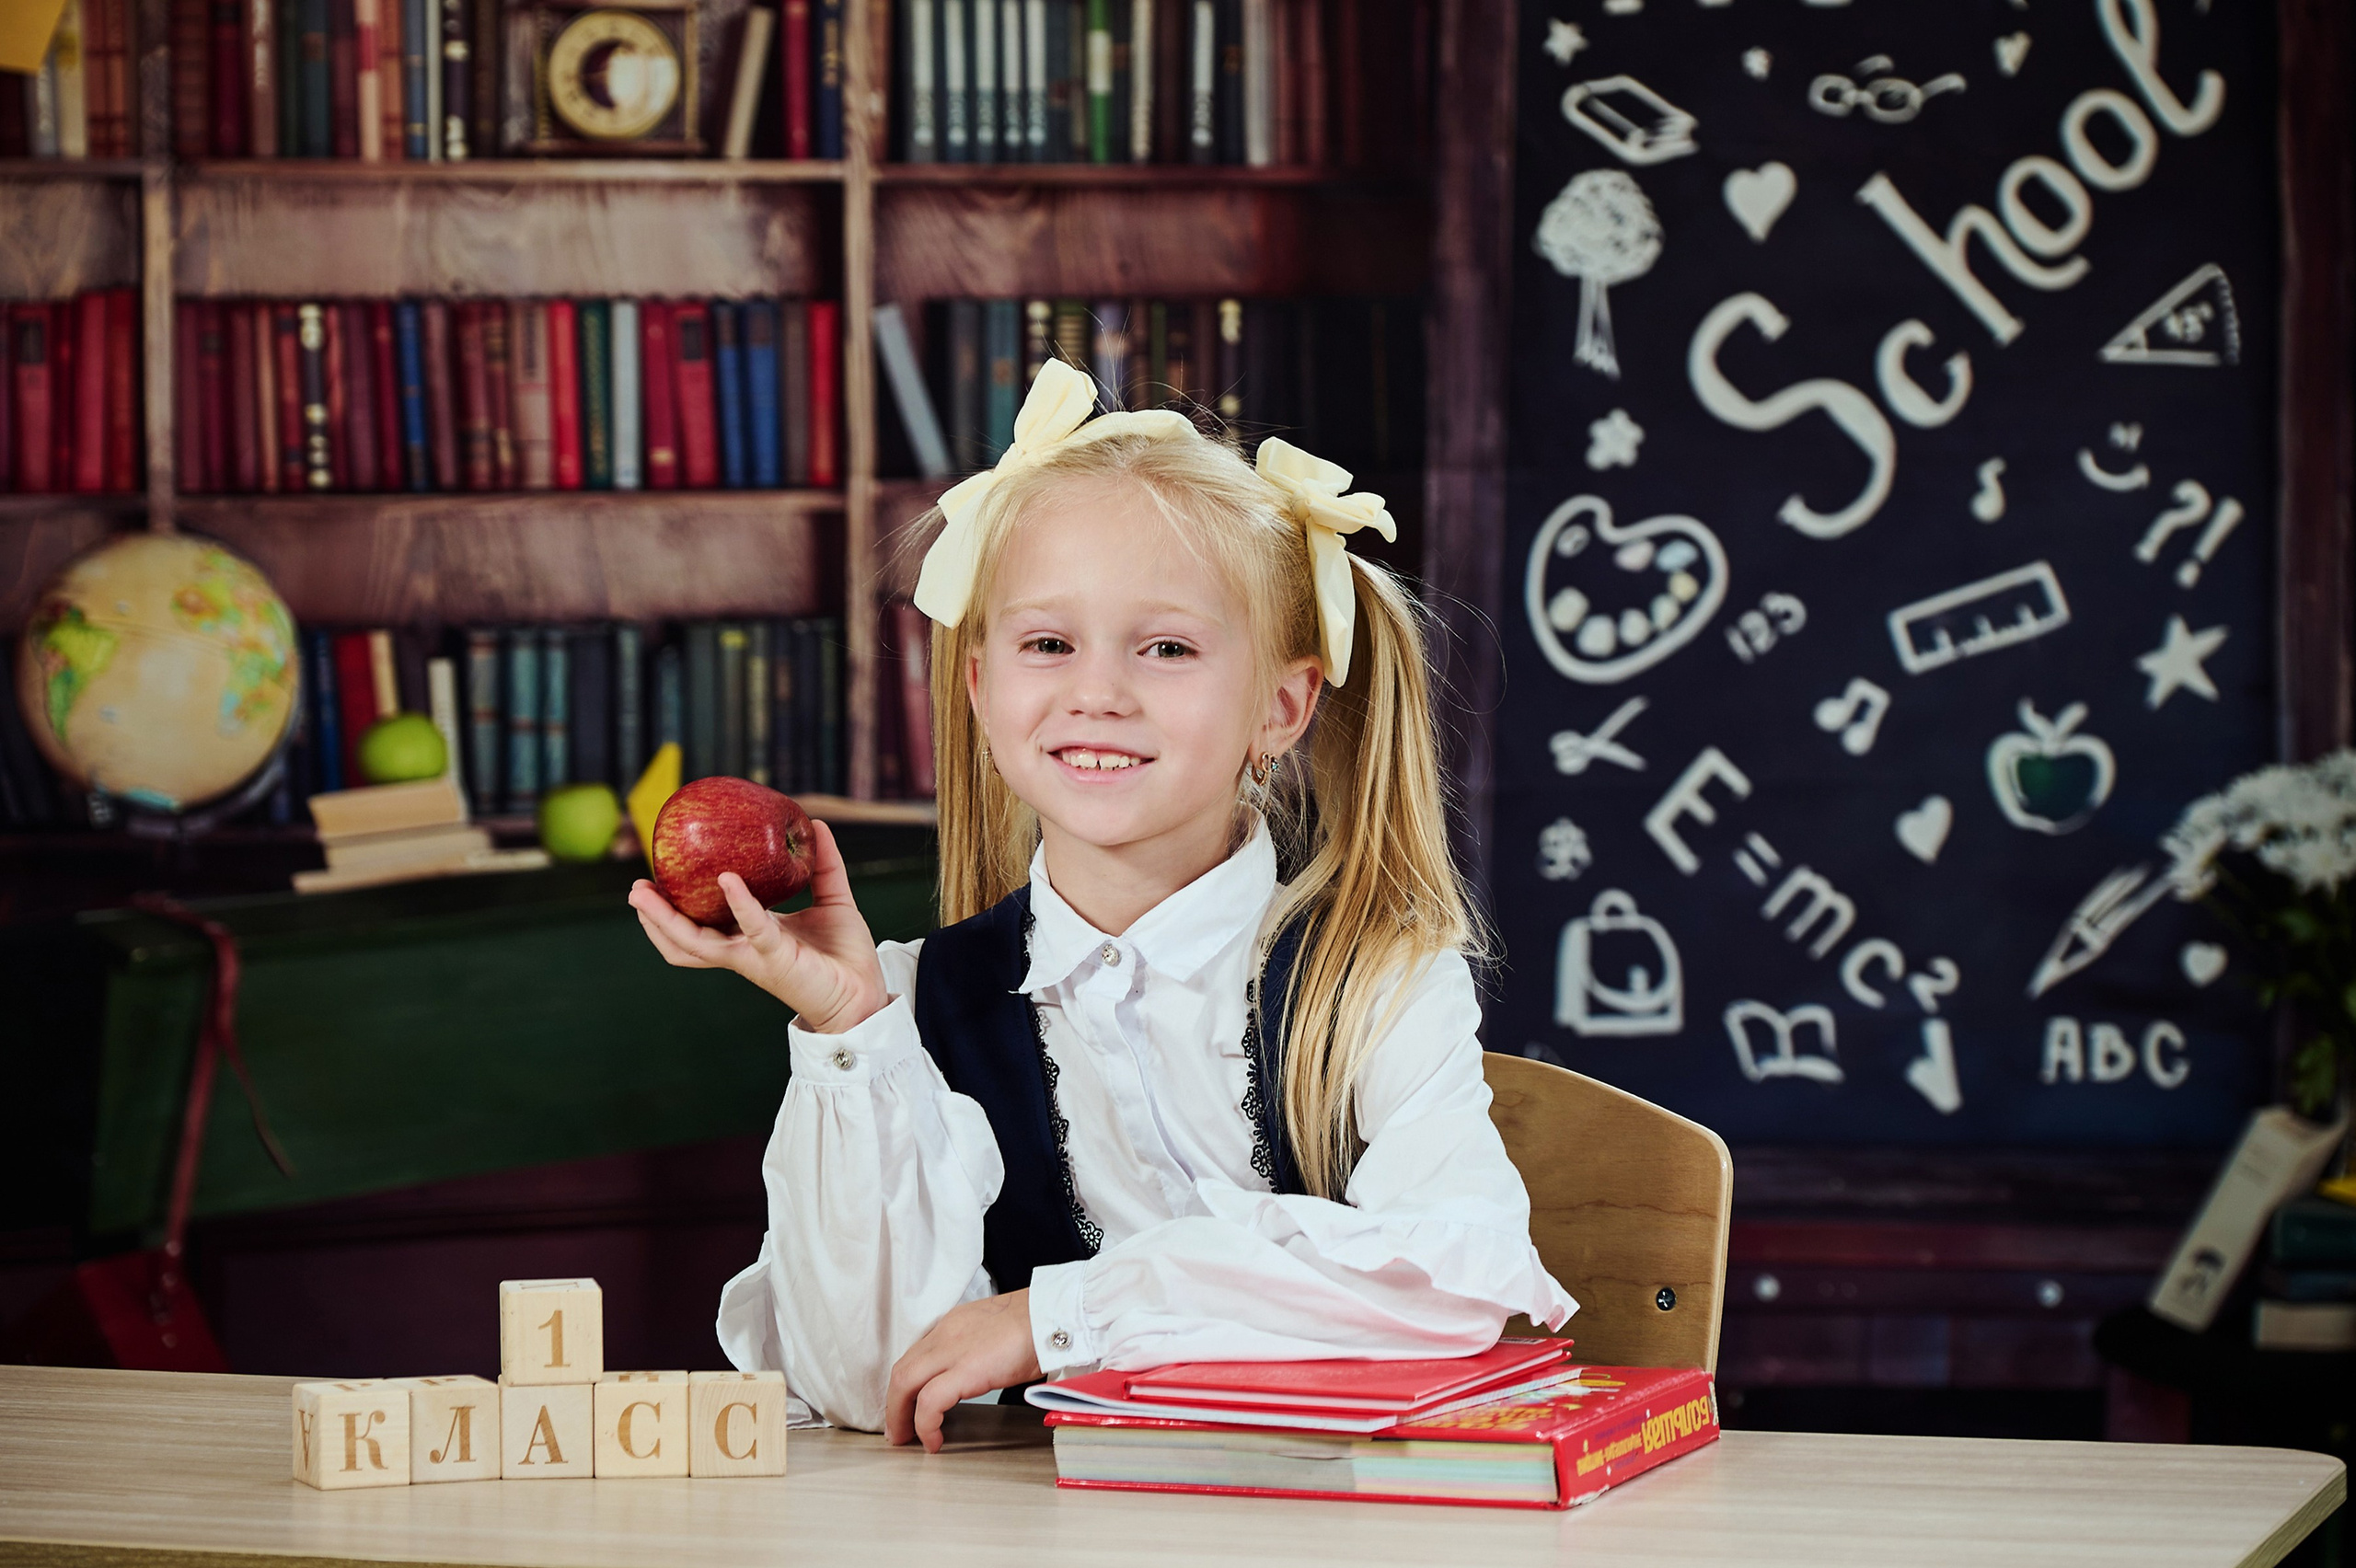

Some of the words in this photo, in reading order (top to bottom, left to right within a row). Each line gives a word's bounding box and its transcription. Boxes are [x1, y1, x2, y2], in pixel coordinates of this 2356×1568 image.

[1688, 0, 2226, 539] School
[1726, 592, 1807, 663] 123
[2040, 1017, 2191, 1089] ABC
[537, 1309, 572, 1368] 1
